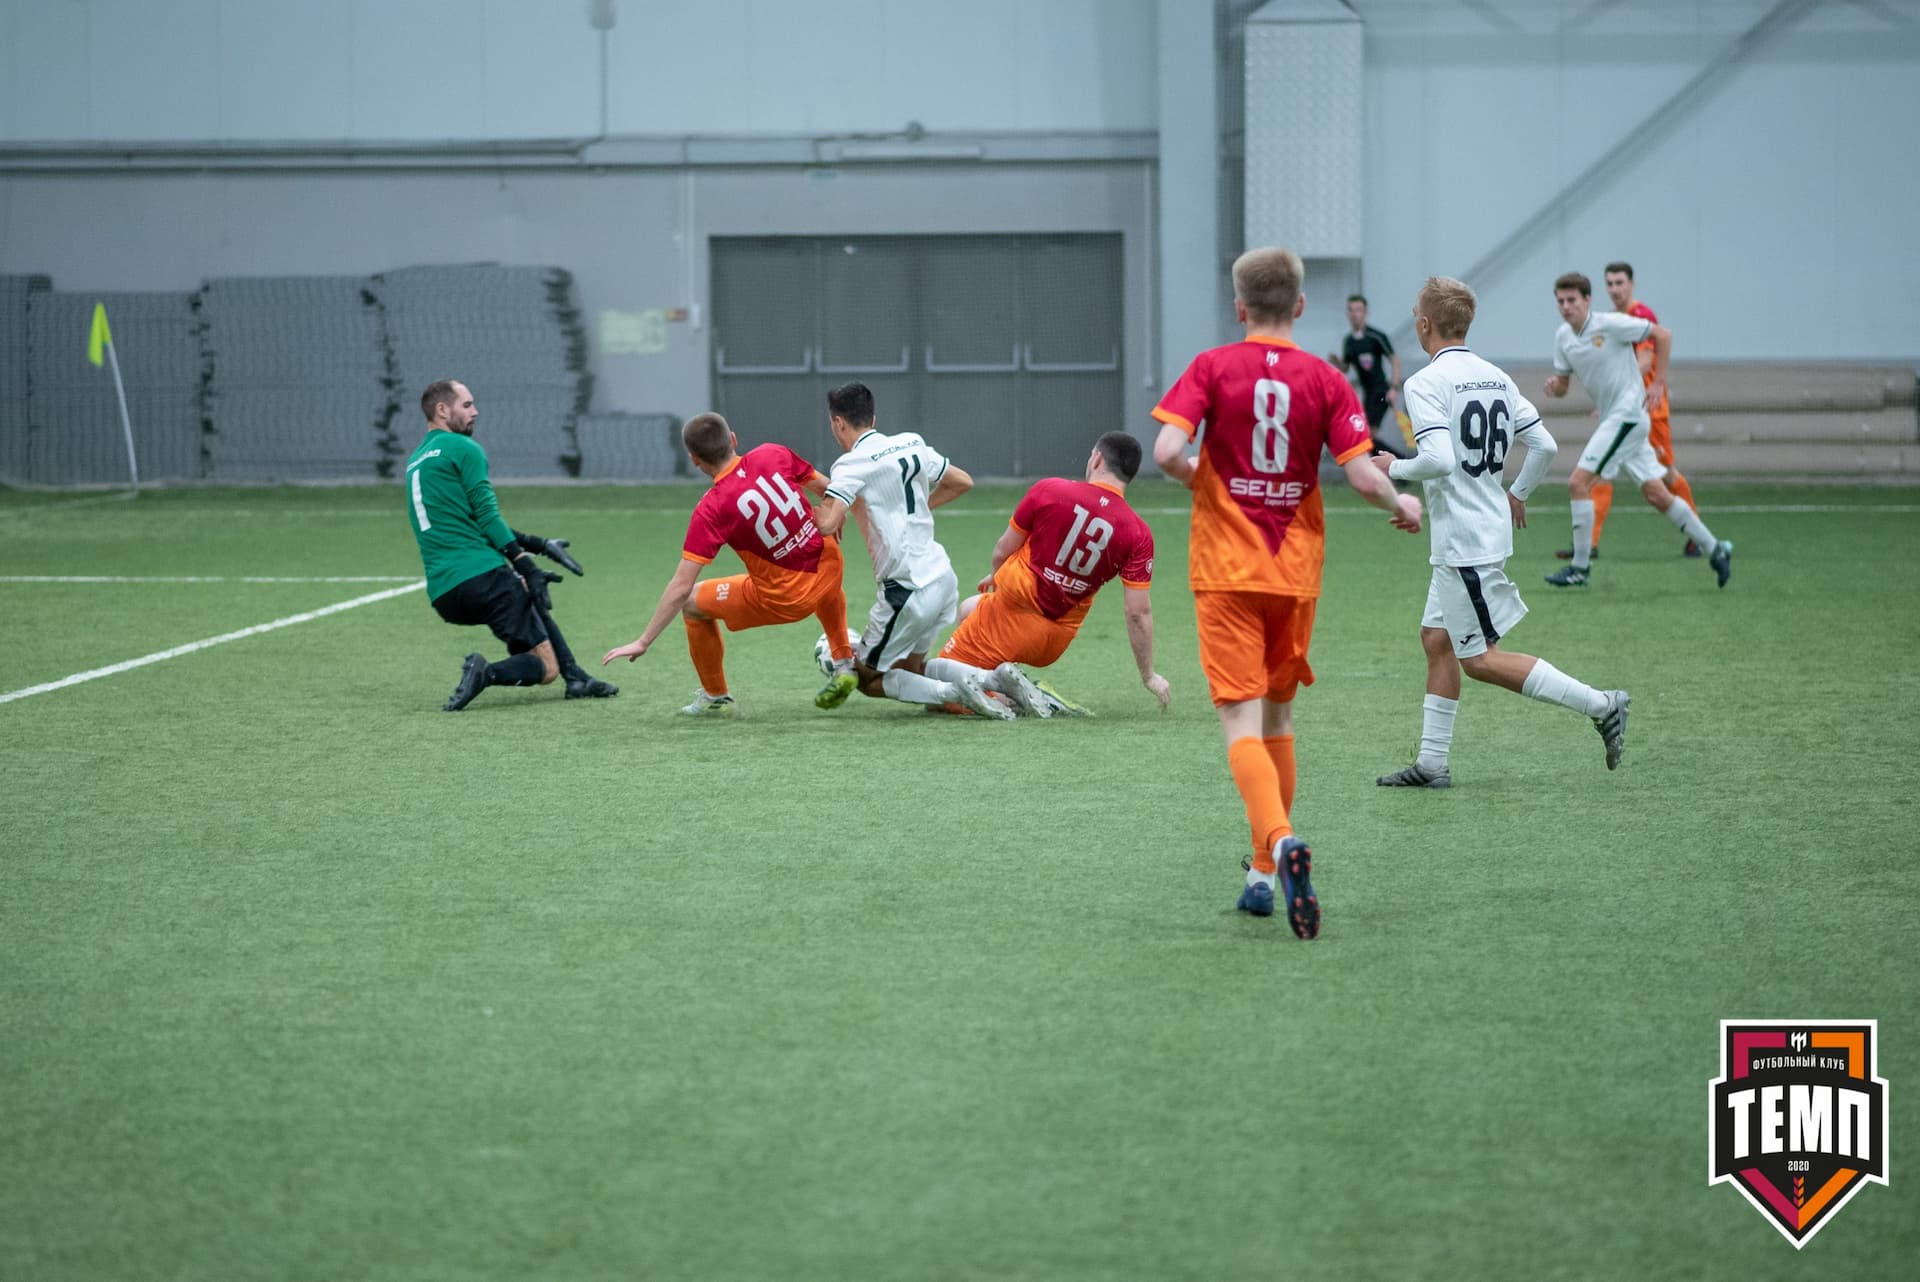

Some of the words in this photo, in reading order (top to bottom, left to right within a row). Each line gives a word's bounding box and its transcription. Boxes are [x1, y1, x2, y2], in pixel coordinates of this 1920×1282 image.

[1252, 378, 1290, 474] 8
[1460, 399, 1509, 477] 96
[412, 468, 431, 532] 1
[736, 472, 806, 549] 24
[1229, 477, 1304, 498] SEUS
[773, 519, 814, 560] SEUS
[1055, 504, 1113, 576] 13
[1043, 566, 1089, 592] SEUS
